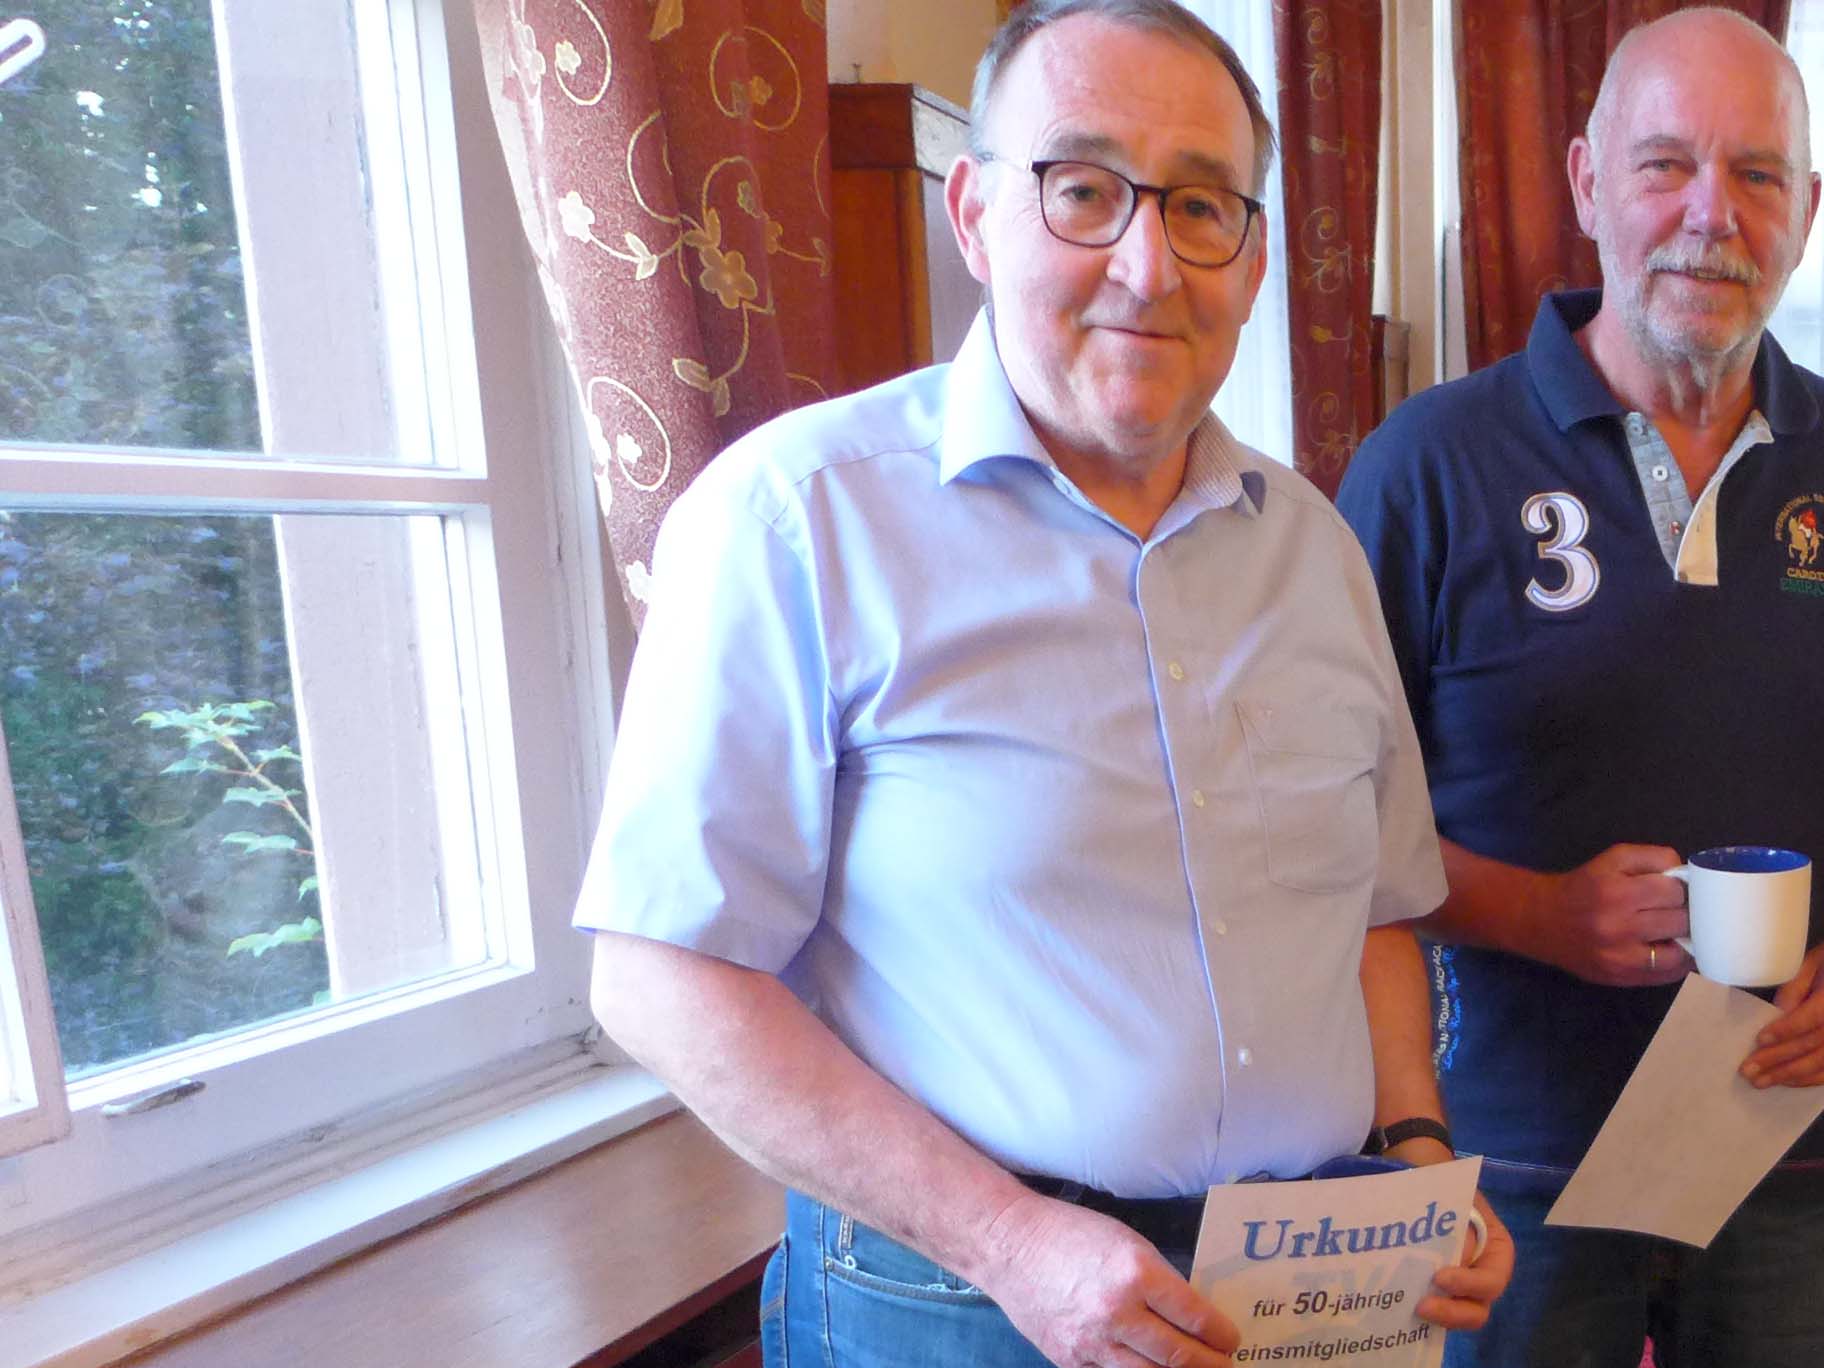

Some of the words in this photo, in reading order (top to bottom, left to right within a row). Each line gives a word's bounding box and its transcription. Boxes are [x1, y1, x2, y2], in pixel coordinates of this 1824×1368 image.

[1521, 492, 1600, 611] 3
[1243, 1201, 1457, 1261] Urkunde
[1253, 1299, 1285, 1318] für
[1292, 1289, 1405, 1317] 50-jährige
[1228, 1324, 1430, 1362] einsmitgliedschaft
